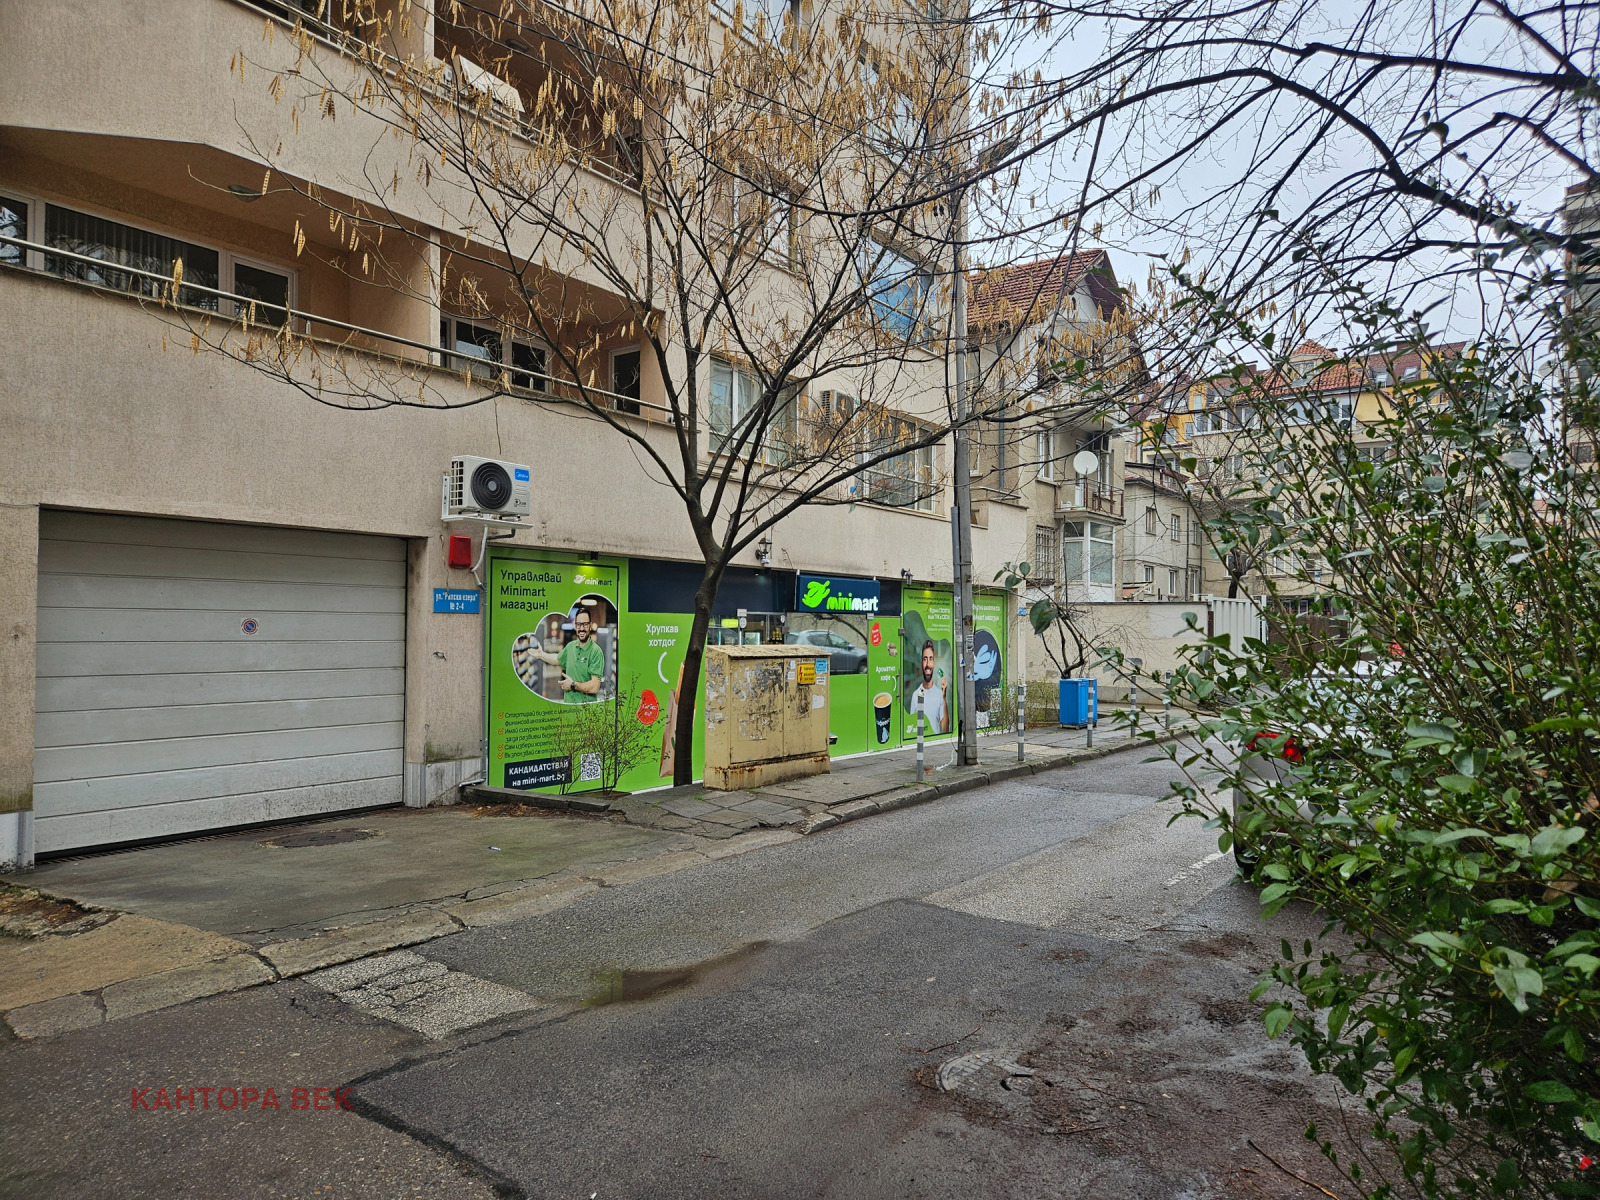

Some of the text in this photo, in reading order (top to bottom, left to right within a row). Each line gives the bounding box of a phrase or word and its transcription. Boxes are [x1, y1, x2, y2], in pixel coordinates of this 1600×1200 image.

[500, 569, 562, 583] Управлявай
[585, 577, 612, 586] minimart
[500, 585, 546, 597] Minimart
[435, 593, 443, 602] ул.
[826, 592, 879, 611] minimart
[456, 602, 464, 610] 2-4
[500, 600, 549, 612] магазин!
[645, 624, 679, 635] Хрупкав
[648, 638, 676, 647] хотдог
[505, 711, 536, 719] Стартирай
[509, 760, 569, 775] КАНДИДАТСТВАЙ
